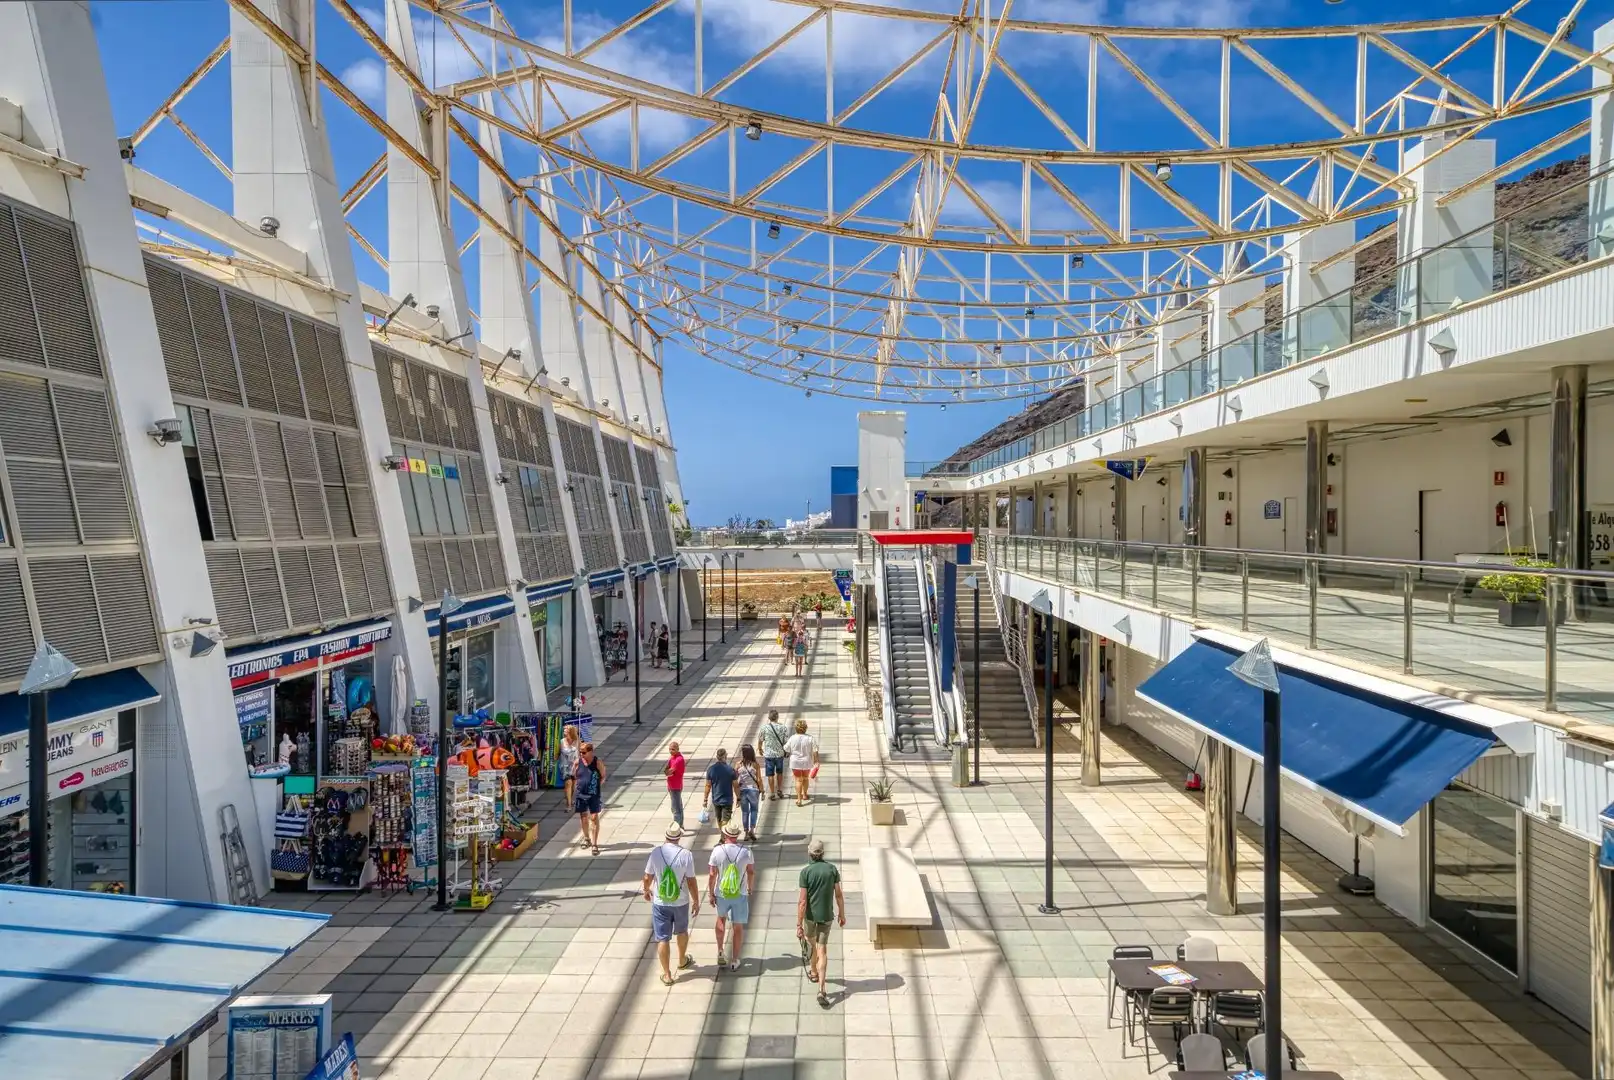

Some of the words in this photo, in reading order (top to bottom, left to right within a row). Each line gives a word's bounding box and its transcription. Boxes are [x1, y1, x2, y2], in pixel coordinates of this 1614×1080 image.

[293, 648, 309, 662] EPA
[320, 638, 350, 655] FASHION
[80, 719, 114, 733] GANT
